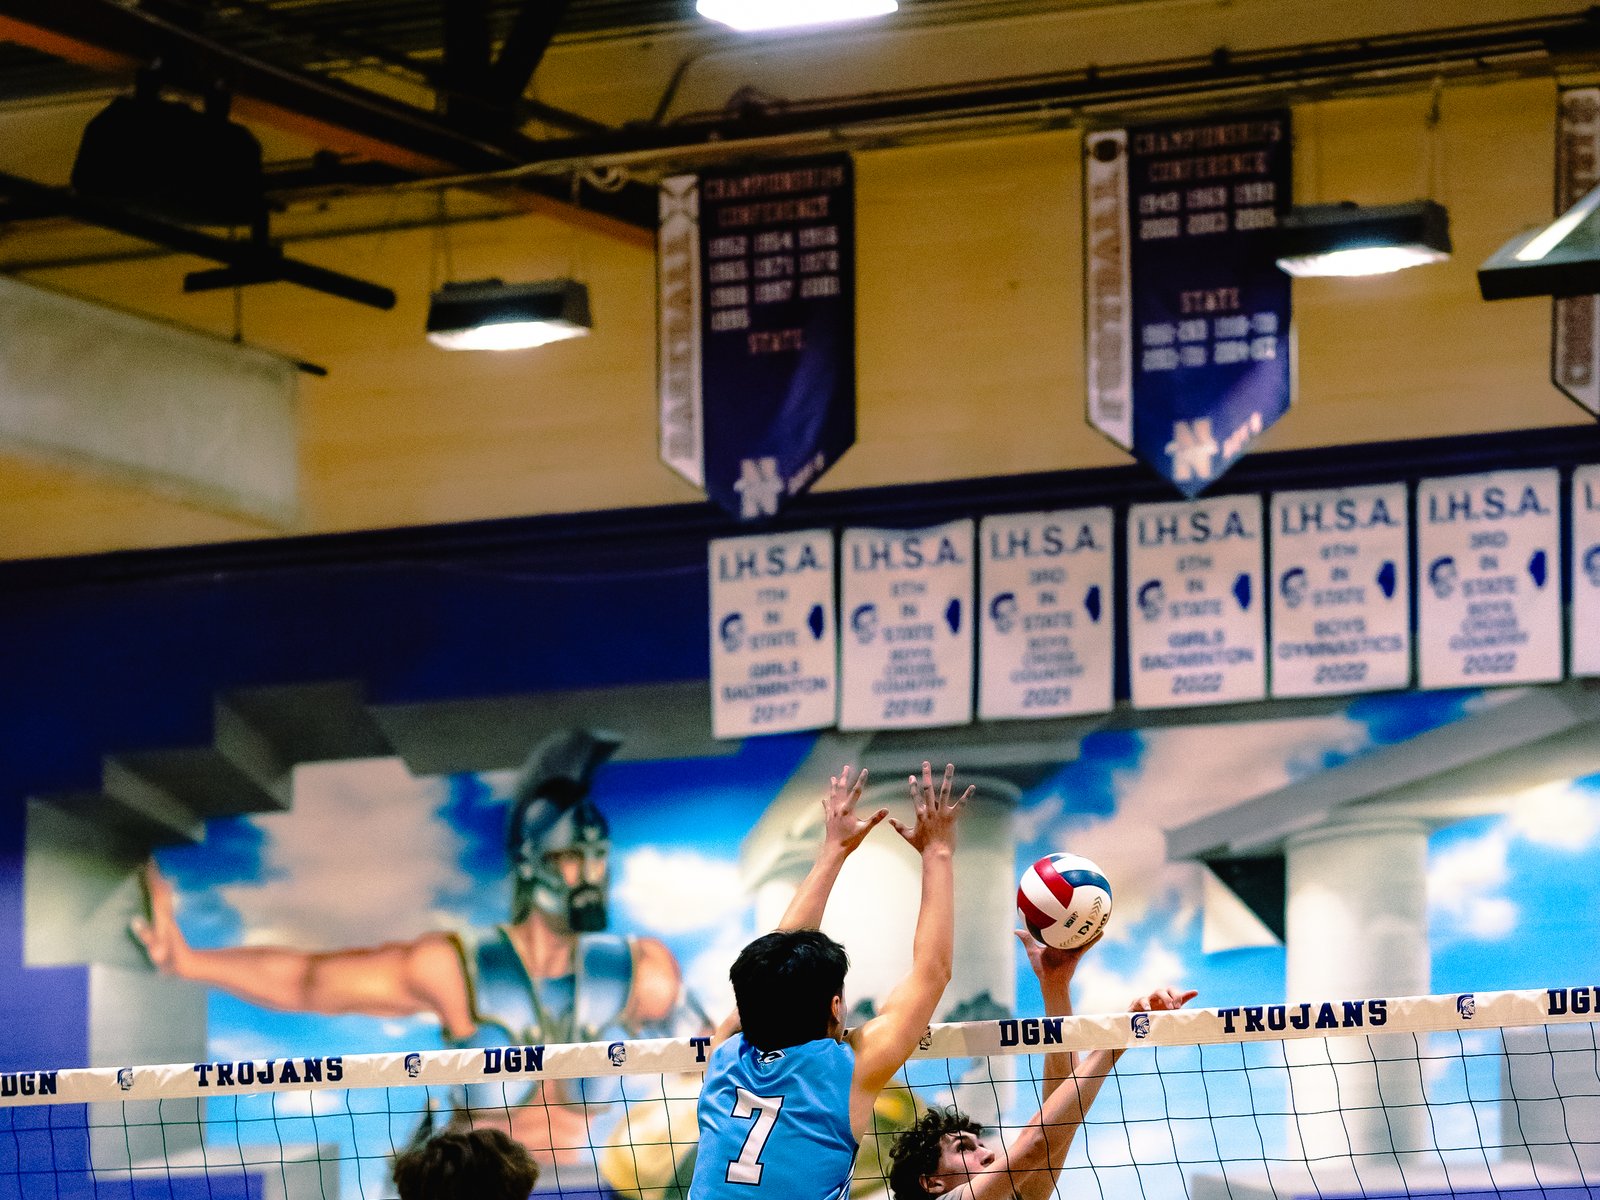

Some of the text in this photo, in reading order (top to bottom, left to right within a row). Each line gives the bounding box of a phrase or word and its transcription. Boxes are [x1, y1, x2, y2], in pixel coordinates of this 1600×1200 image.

[1181, 288, 1240, 313] STATE
[1470, 530, 1509, 549] 3RD
[1479, 554, 1499, 570] IN
[1331, 566, 1349, 581] IN
[1185, 578, 1204, 593] IN
[1462, 575, 1517, 598] STATE
[1038, 591, 1057, 606] IN
[1313, 586, 1366, 608] STATE
[765, 610, 781, 625] IN
[900, 603, 918, 618] IN
[1168, 599, 1222, 620] STATE
[1467, 600, 1514, 617] BOYS
[1022, 611, 1075, 632] STATE
[1314, 616, 1366, 638] BOYS
[749, 630, 798, 650] STATE
[882, 623, 935, 644] STATE
[1168, 628, 1225, 648] GIRLS
[1449, 631, 1529, 652] COUNTRY
[1278, 634, 1403, 661] GYMNASTICS
[749, 659, 800, 679] GIRLS
[1140, 647, 1254, 673] BADMINTON
[1010, 664, 1085, 684] COUNTRY
[721, 677, 829, 703] BADMINTON
[872, 676, 948, 696] COUNTRY
[1218, 999, 1388, 1034] TROJANS
[998, 1018, 1064, 1047] DGN
[483, 1046, 545, 1075] DGN
[193, 1056, 345, 1087] TROJANS
[0, 1070, 58, 1097] DGN
[725, 1086, 785, 1186] 7
